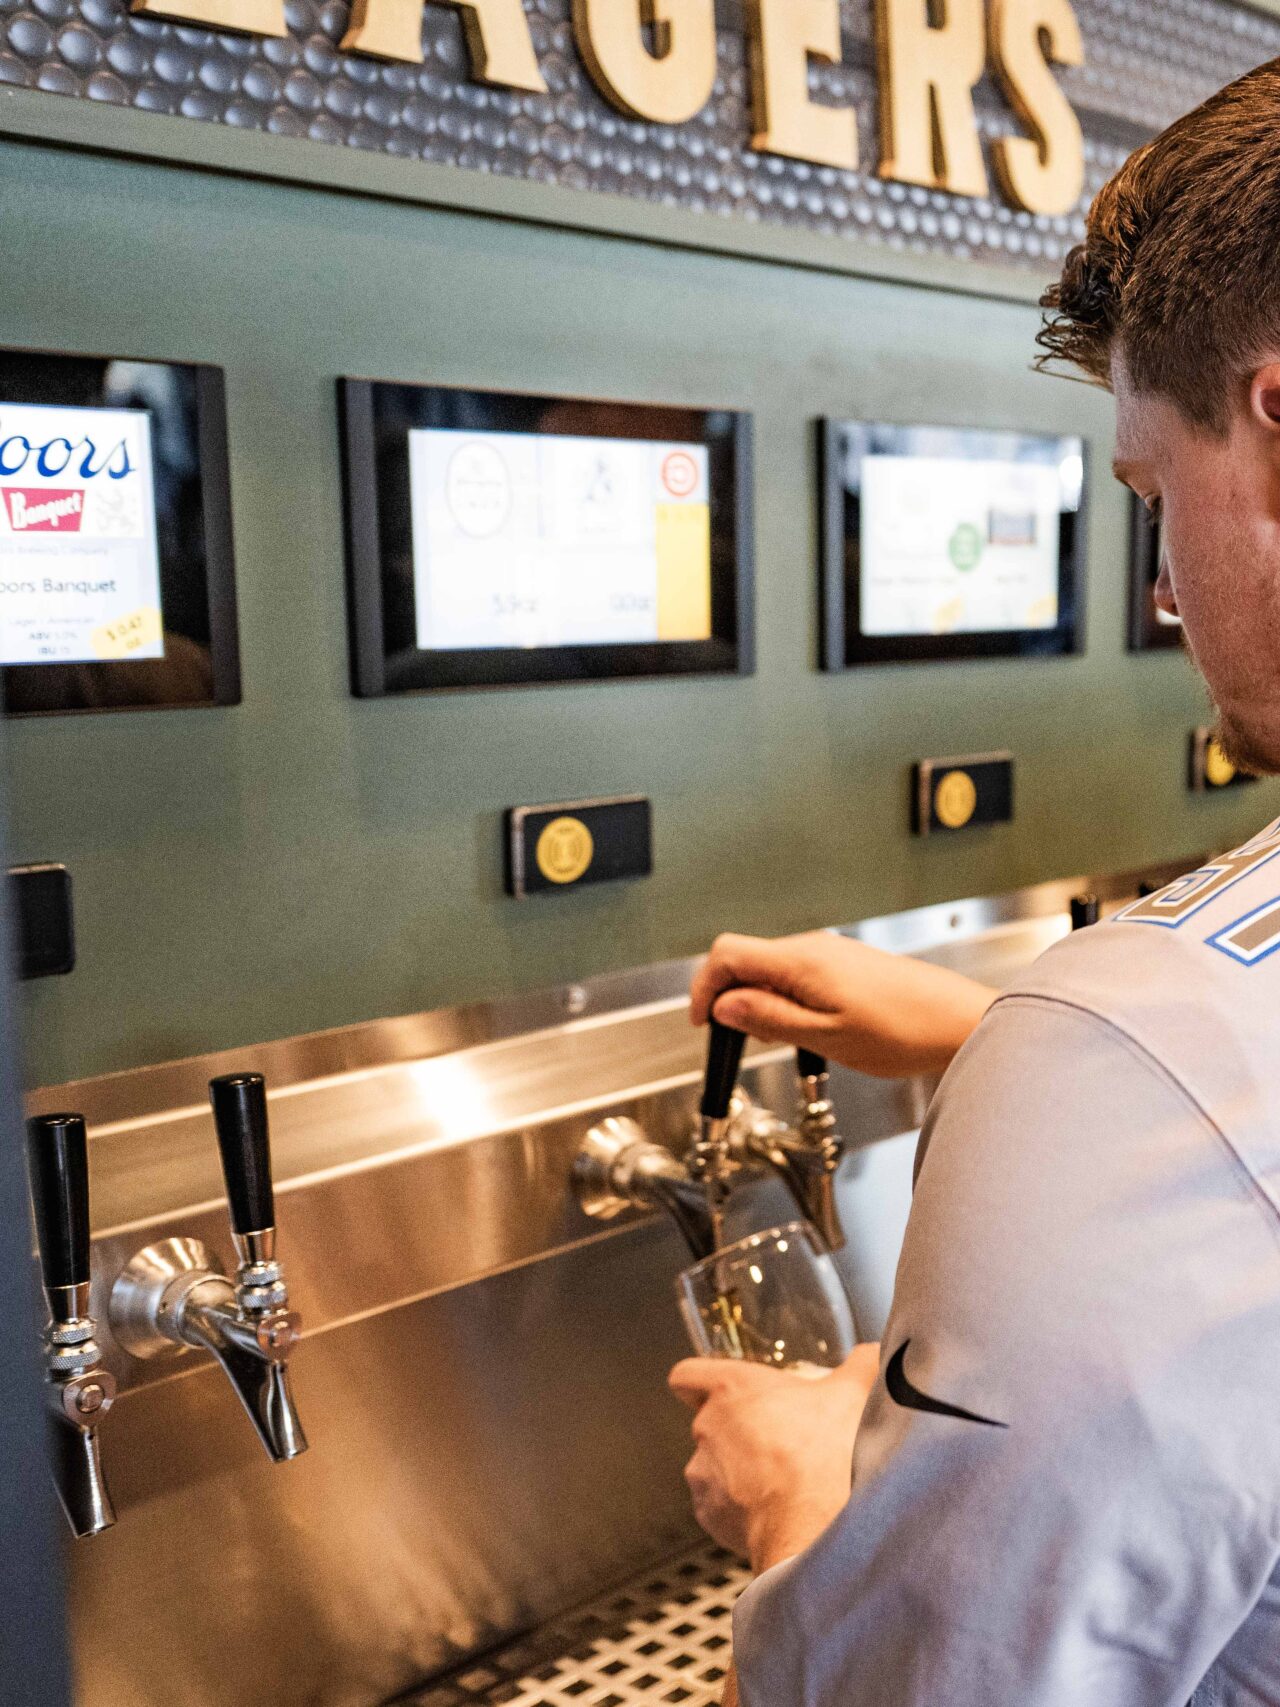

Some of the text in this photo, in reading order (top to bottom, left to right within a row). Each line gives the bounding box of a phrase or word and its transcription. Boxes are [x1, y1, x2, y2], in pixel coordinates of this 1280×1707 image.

[0, 434, 136, 479] oors
[0, 578, 117, 597] oors Banquet
